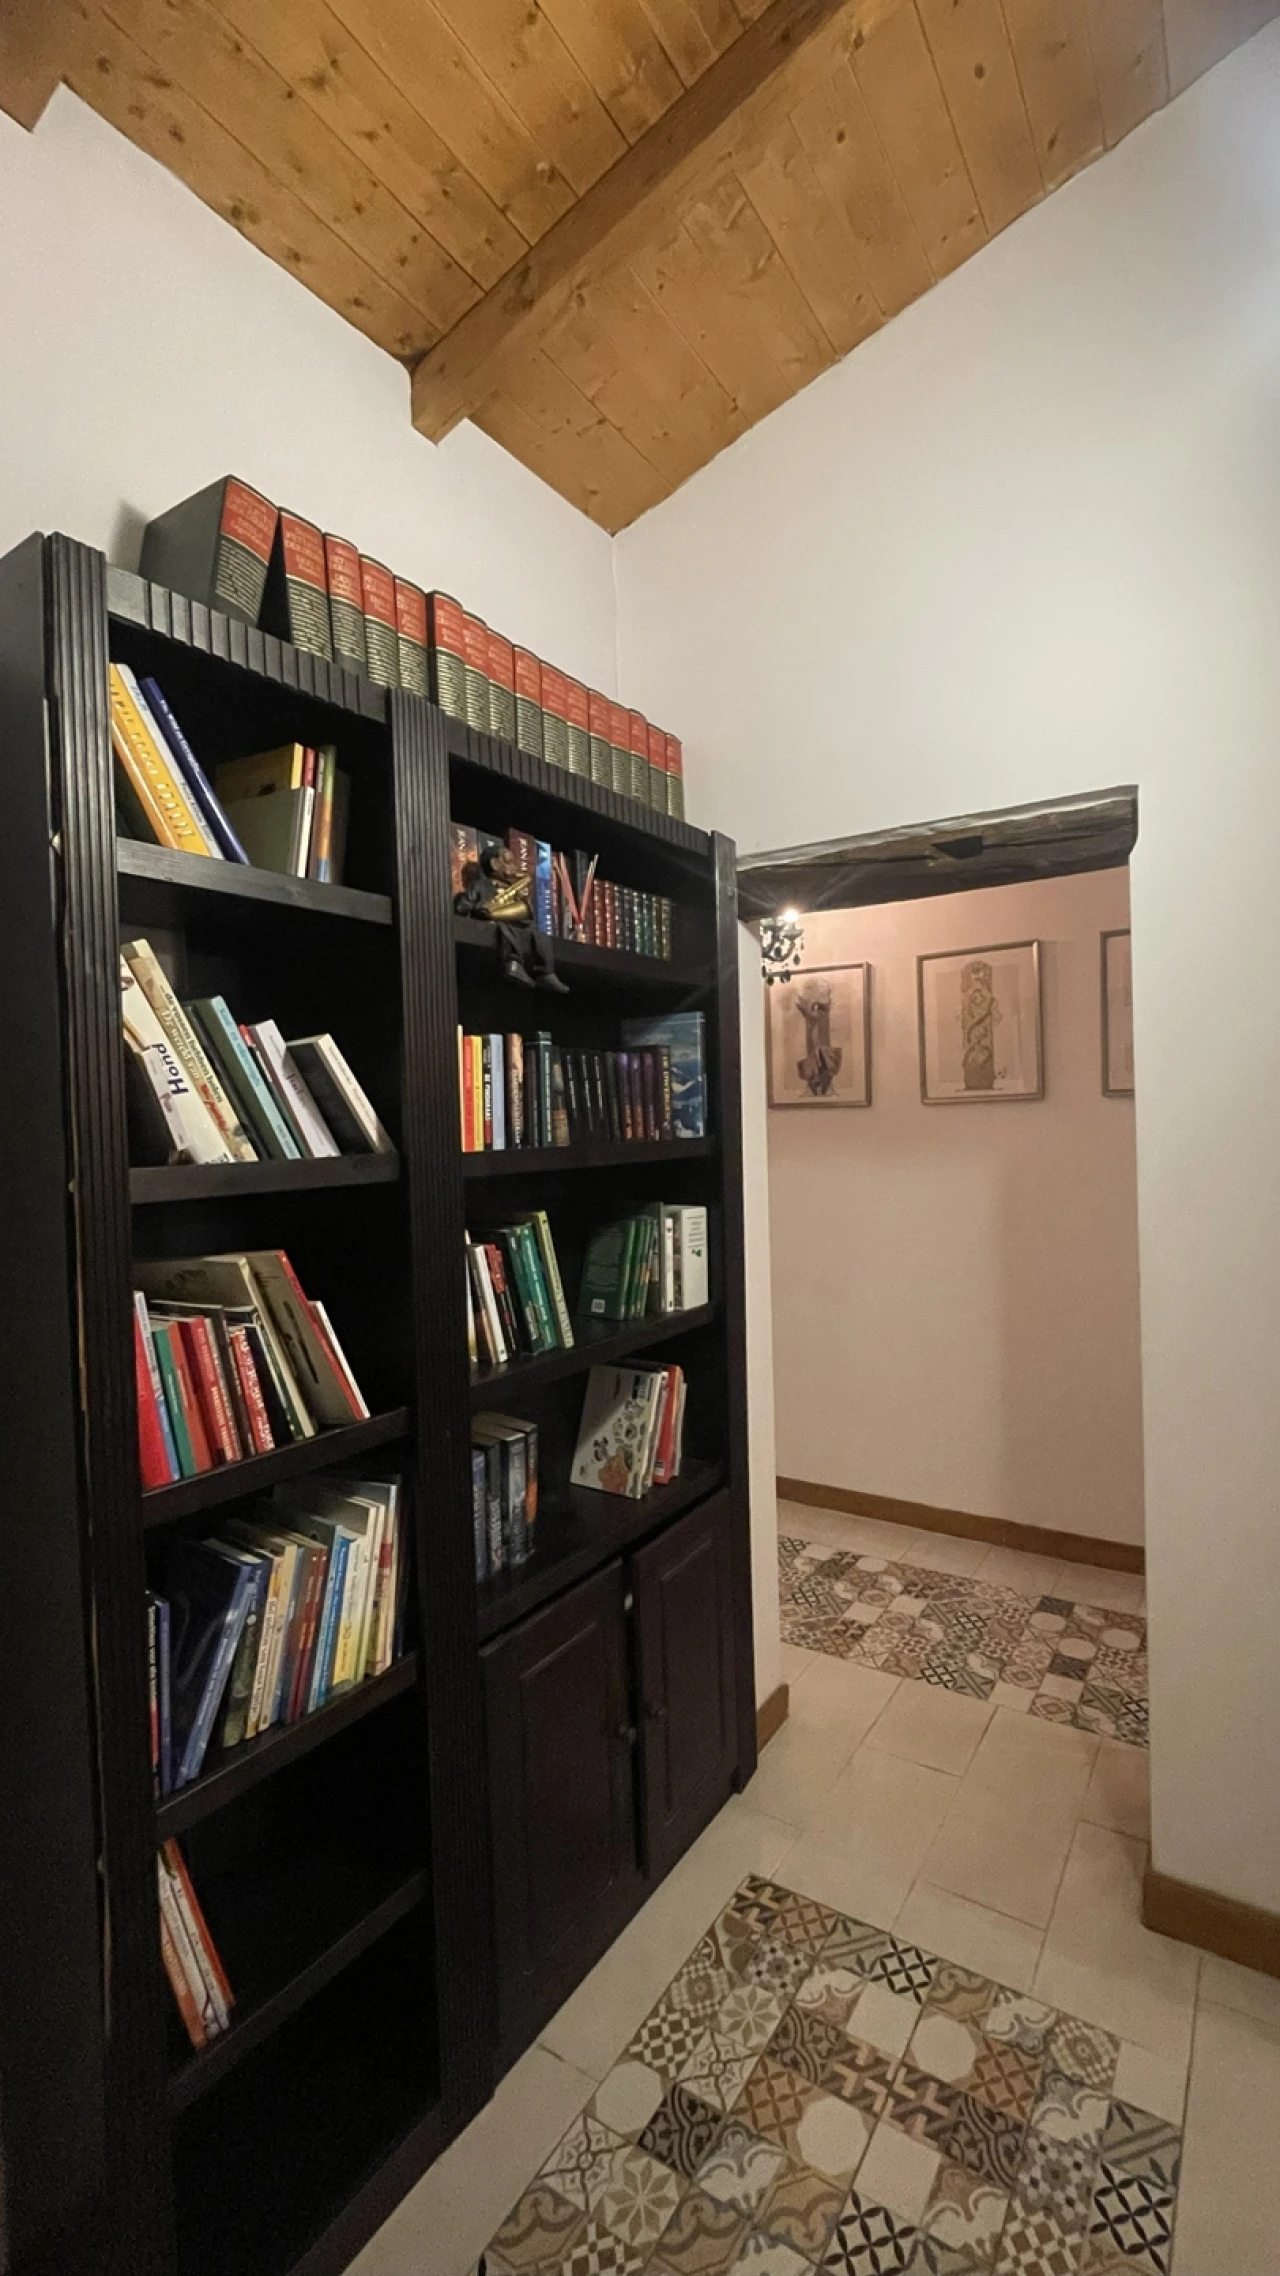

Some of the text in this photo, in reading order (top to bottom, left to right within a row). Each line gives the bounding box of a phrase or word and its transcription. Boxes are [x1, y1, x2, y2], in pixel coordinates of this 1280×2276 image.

[151, 1043, 189, 1095] Hond
[186, 1039, 212, 1075] hebben
[204, 1075, 225, 1103] holen
